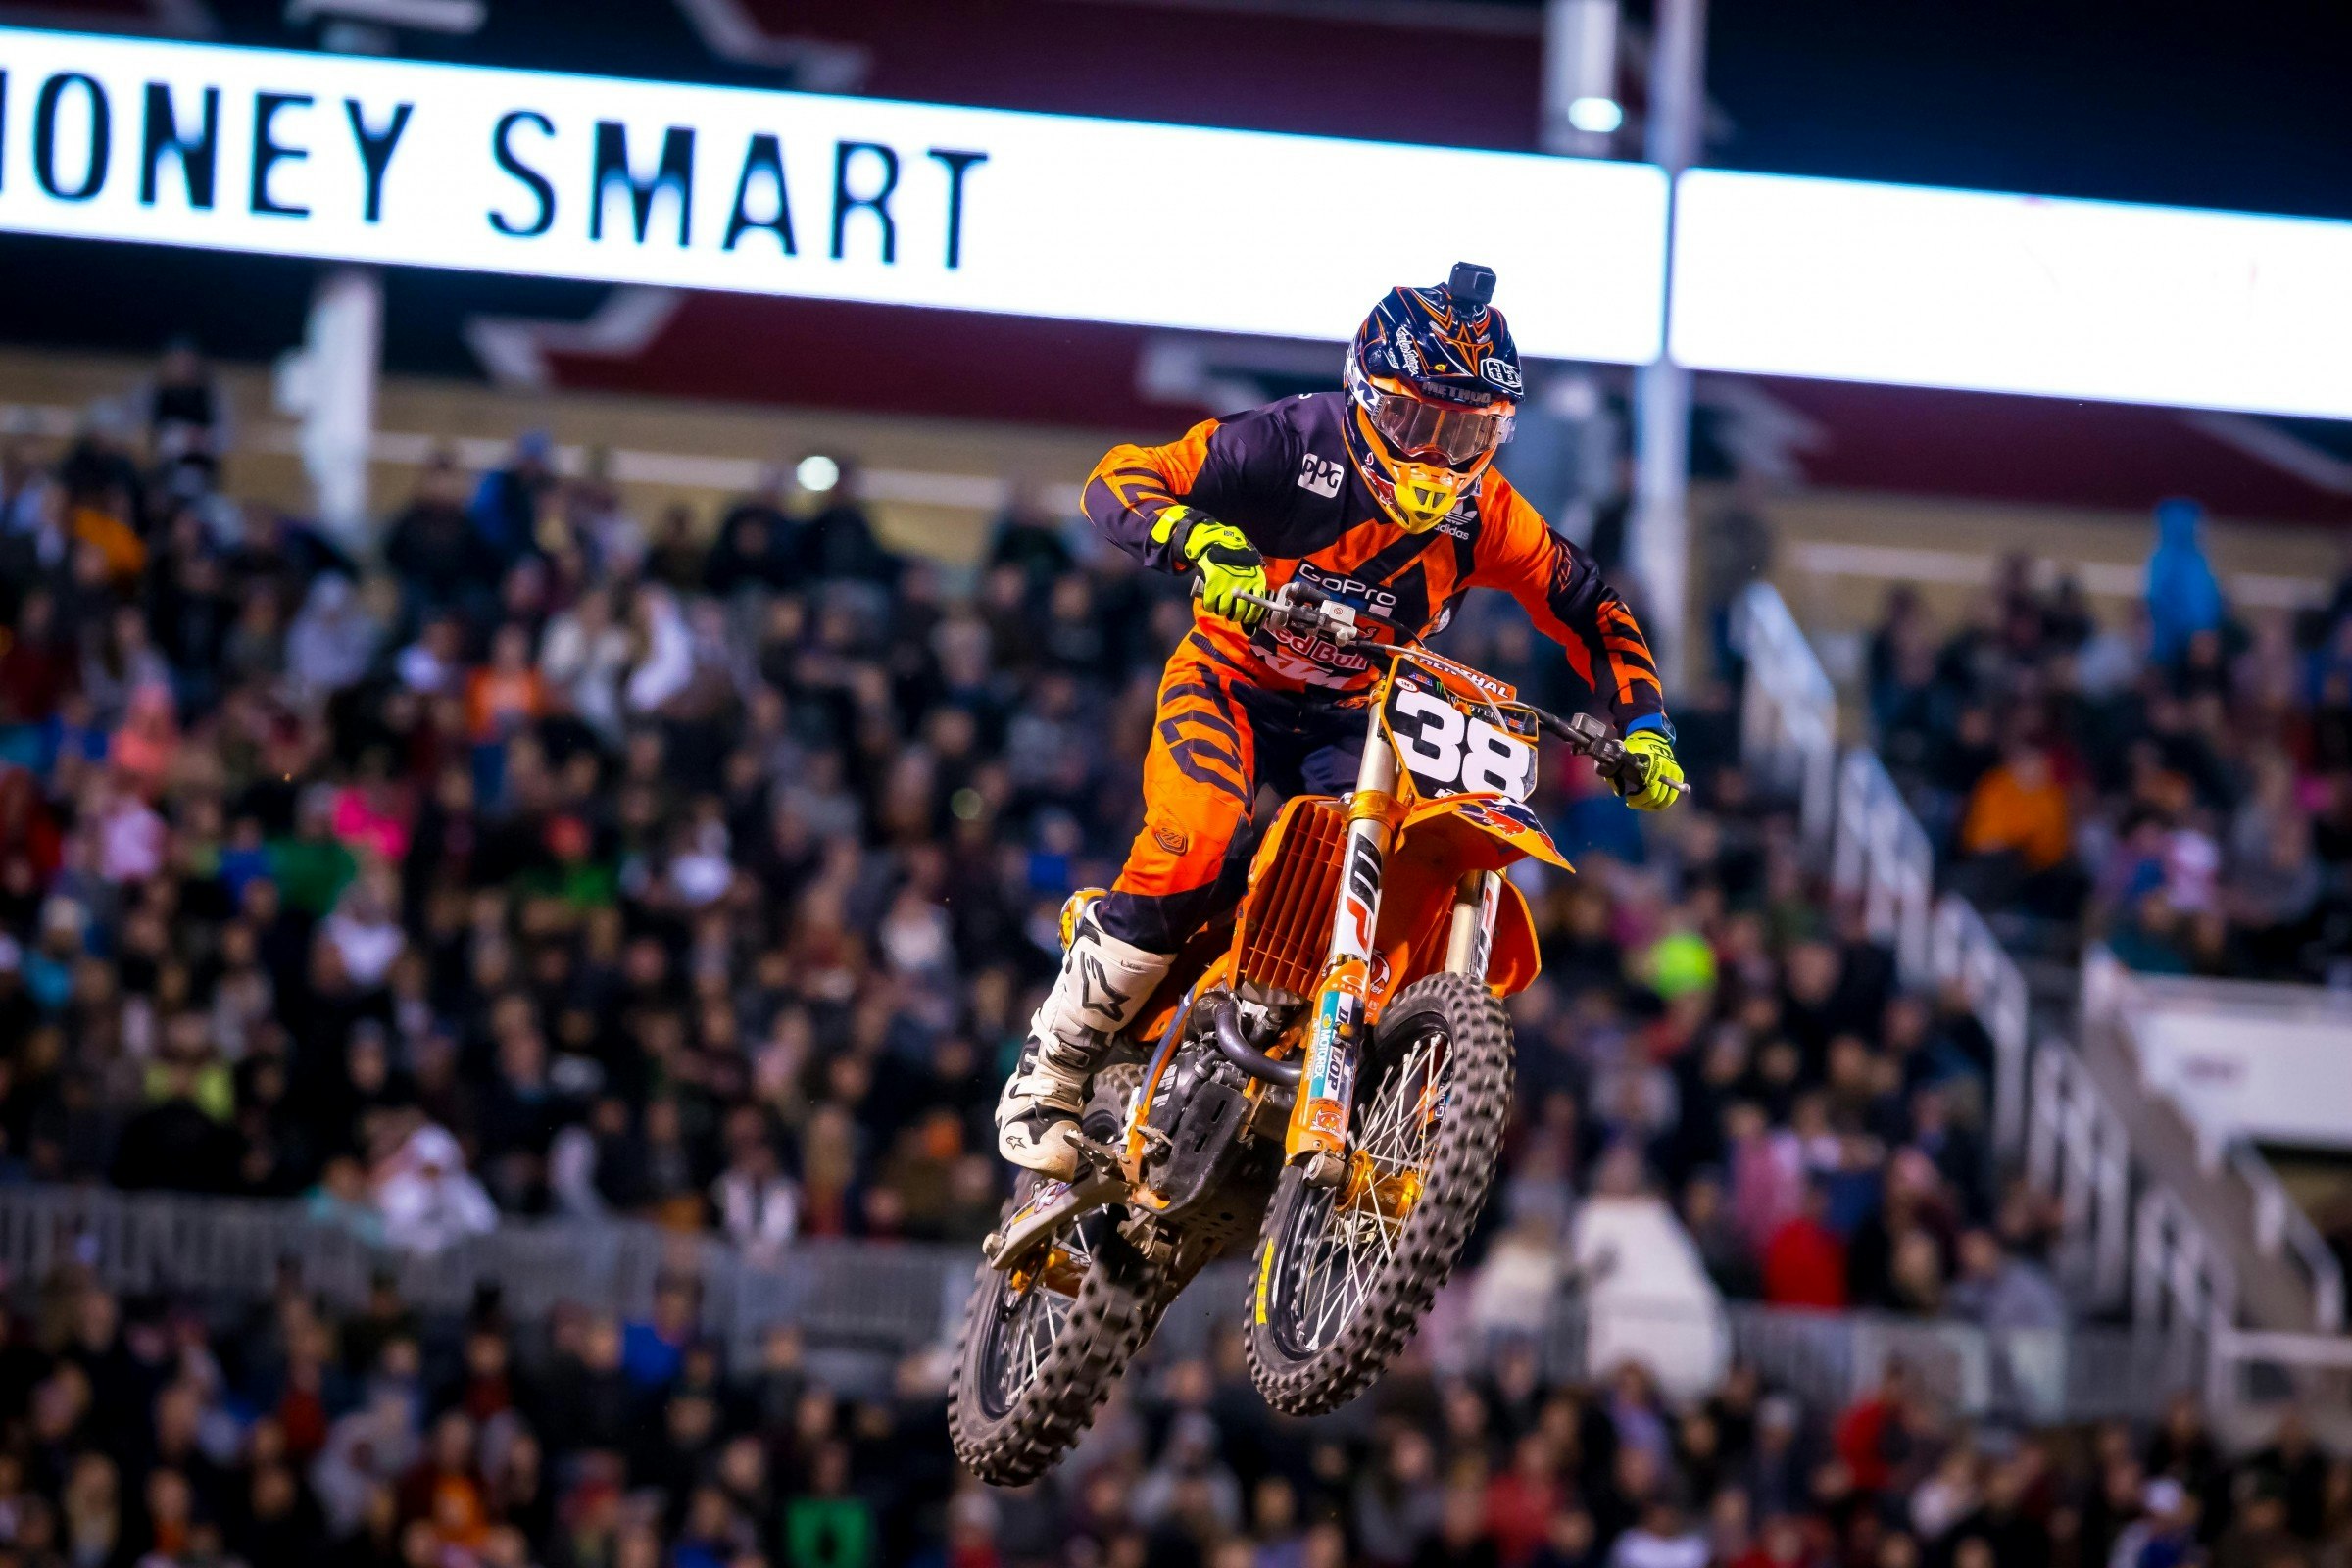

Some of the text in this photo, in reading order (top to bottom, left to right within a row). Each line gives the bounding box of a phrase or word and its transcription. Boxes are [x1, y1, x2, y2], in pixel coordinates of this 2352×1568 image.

[0, 69, 989, 270] ONEY SMART
[1298, 563, 1397, 606] GoPro
[1265, 622, 1368, 670] ed Bull
[1393, 688, 1530, 803] 38
[1313, 1029, 1331, 1079] MOTOREX
[1327, 1006, 1349, 1091] DLOP
